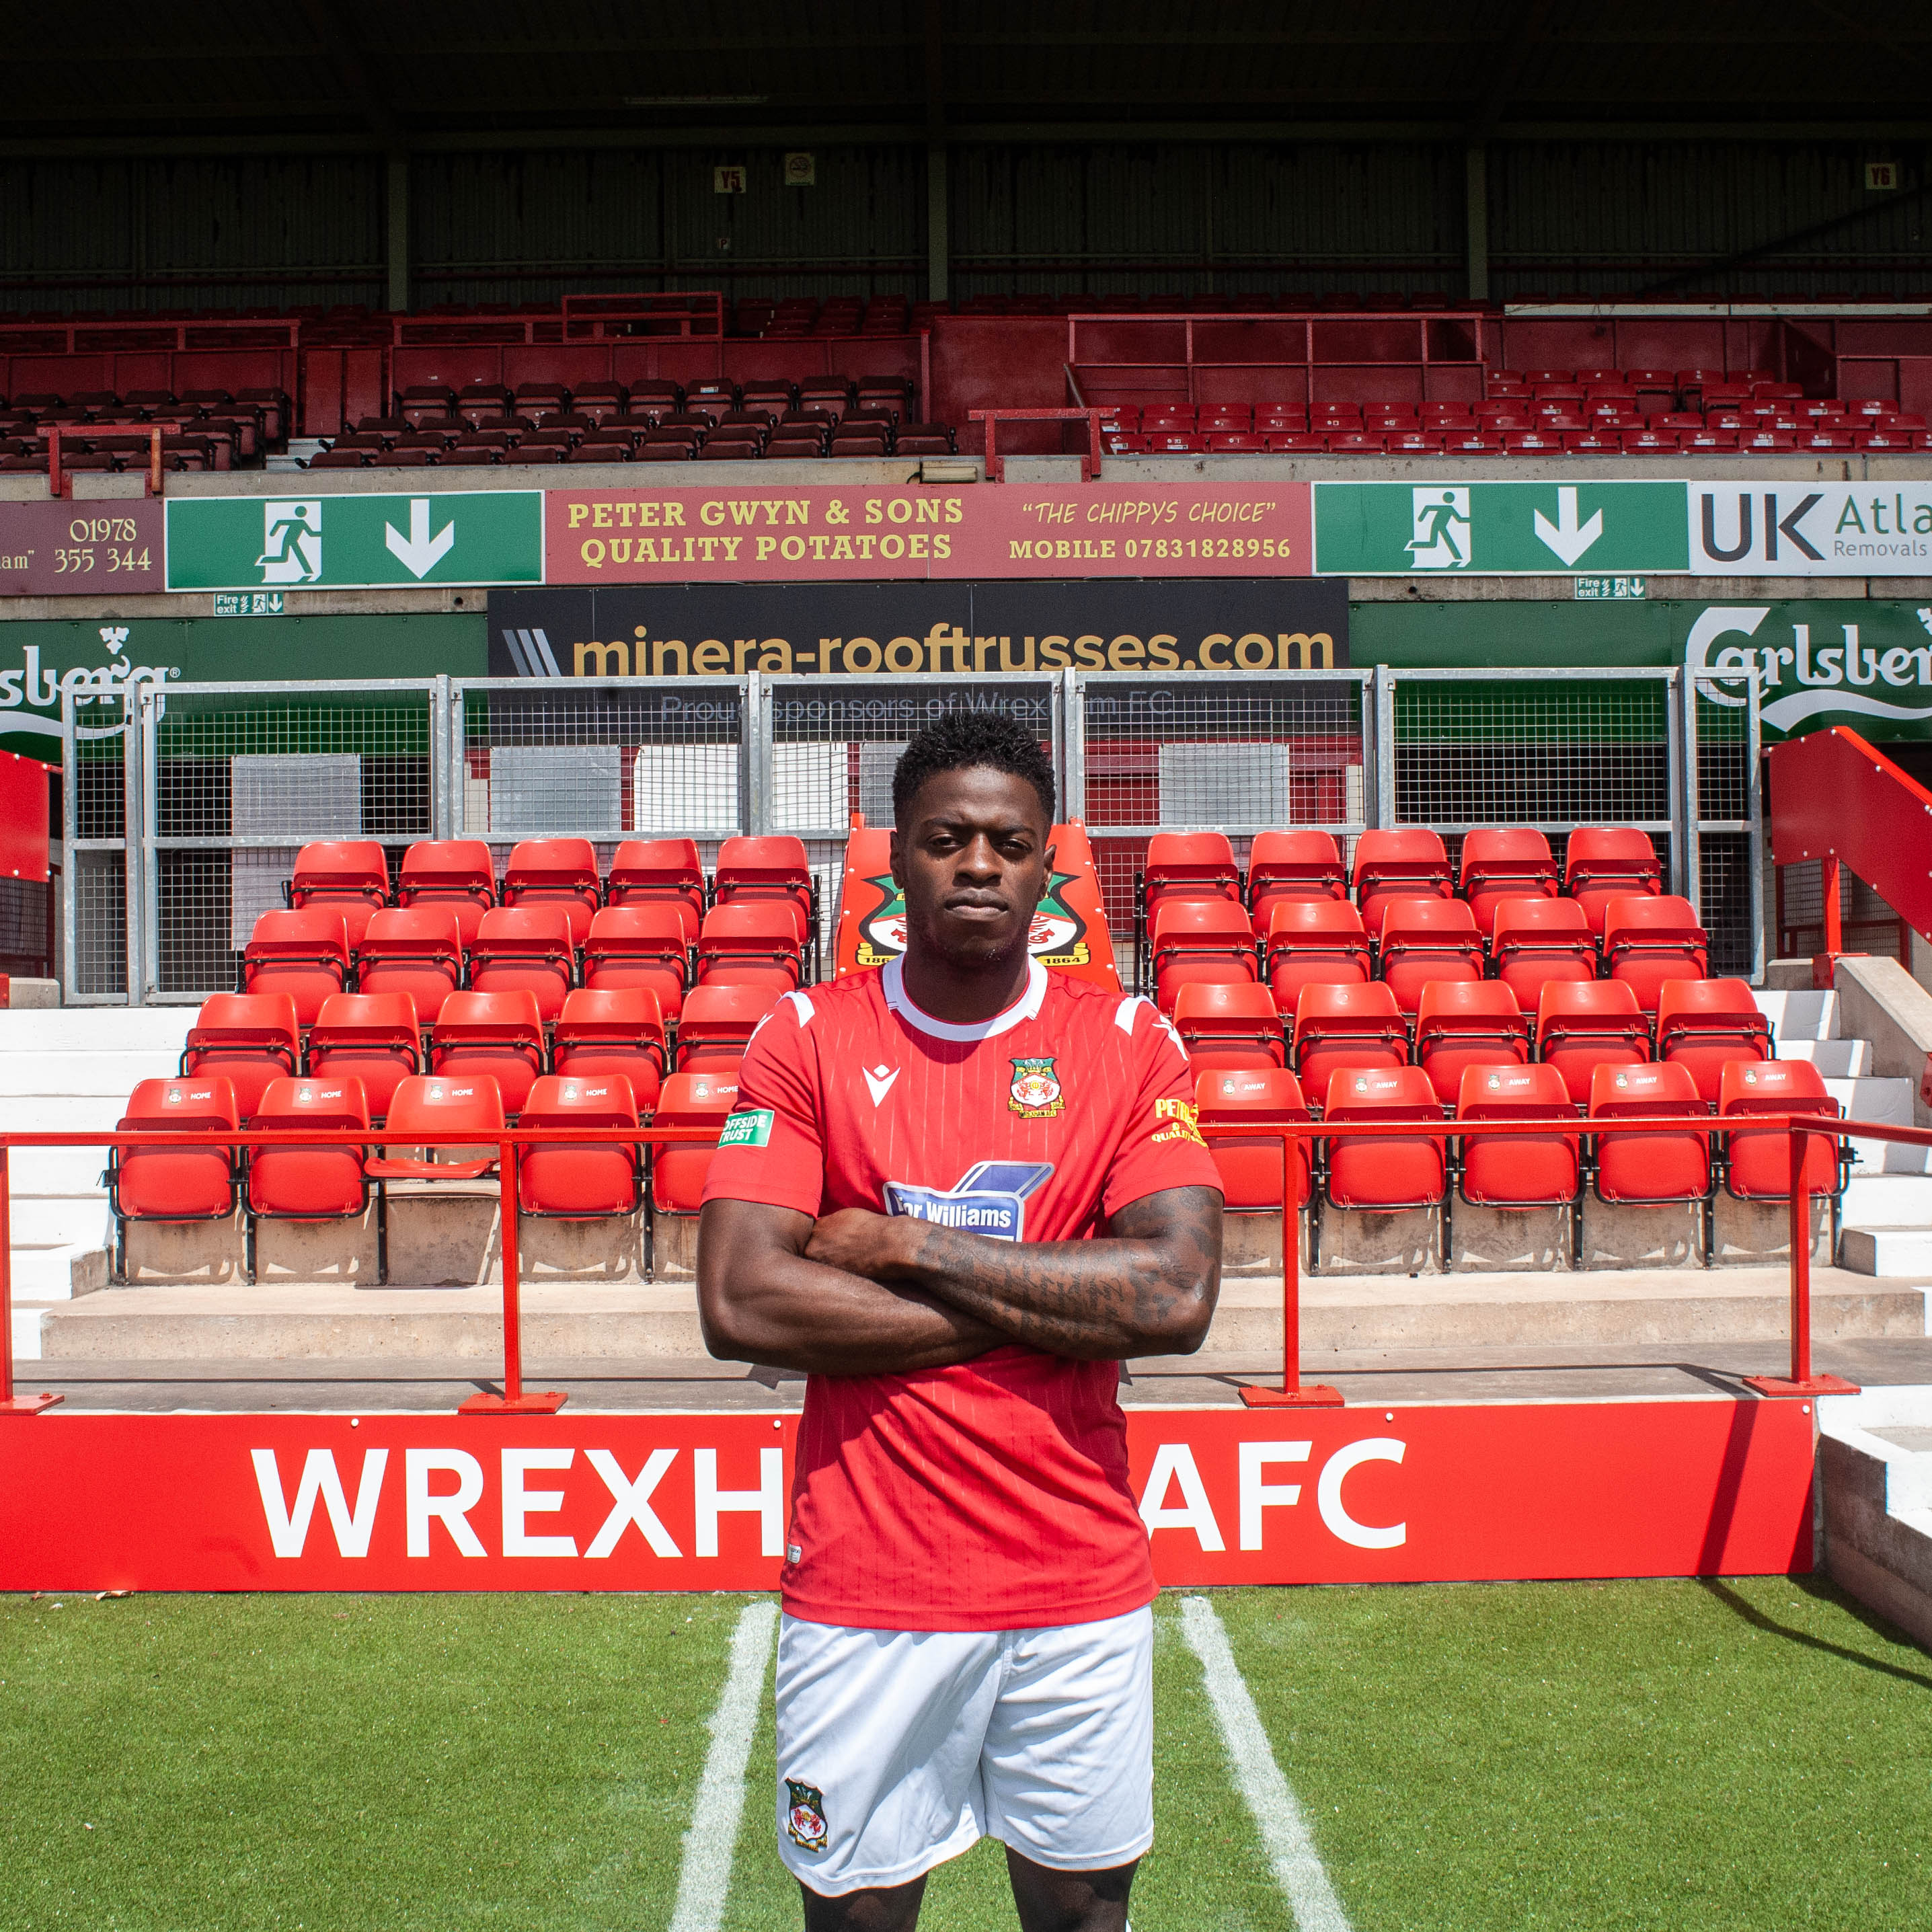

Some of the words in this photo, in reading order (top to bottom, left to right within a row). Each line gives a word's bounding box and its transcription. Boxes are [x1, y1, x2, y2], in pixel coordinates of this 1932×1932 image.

[568, 502, 686, 529] PETER
[700, 500, 810, 527] GWYN
[825, 499, 850, 525] &
[865, 498, 963, 525] SONS
[1087, 501, 1177, 525] CHIPPYS
[1701, 494, 1827, 562] UK
[580, 537, 743, 569] QUALITY
[756, 534, 952, 562] POTATOES
[1009, 540, 1116, 559] MOBILE
[1125, 539, 1290, 559] 07831828956
[1834, 541, 1927, 557] Removals
[54, 547, 95, 573] 355
[106, 547, 153, 572] 344
[1578, 578, 1600, 588] Fire
[1578, 588, 1598, 597] exit
[217, 594, 238, 605] Fire
[217, 605, 237, 614] exit
[574, 623, 1334, 674] minera-rooftrusses.com
[662, 696, 741, 722] Prou
[773, 697, 915, 725] sponsors
[925, 692, 958, 719] of
[965, 691, 1116, 717] Wrexm
[1129, 690, 1172, 716] FC
[1508, 1078, 1530, 1086] AWAY
[1635, 1076, 1657, 1084] AWAY
[1765, 1073, 1786, 1081] AWAY
[717, 1085, 738, 1093] HOME
[1243, 1082, 1266, 1091] AWAY
[1376, 1081, 1397, 1089] AWAY
[190, 1091, 211, 1099] HOME
[321, 1090, 342, 1098] HOME
[452, 1088, 473, 1096] HOME
[586, 1088, 607, 1096] HOME
[723, 1114, 767, 1131] OFFSIDE
[925, 1201, 1011, 1228] Williams
[250, 1447, 784, 1559] WREXH
[1138, 1437, 1407, 1553] AFC
